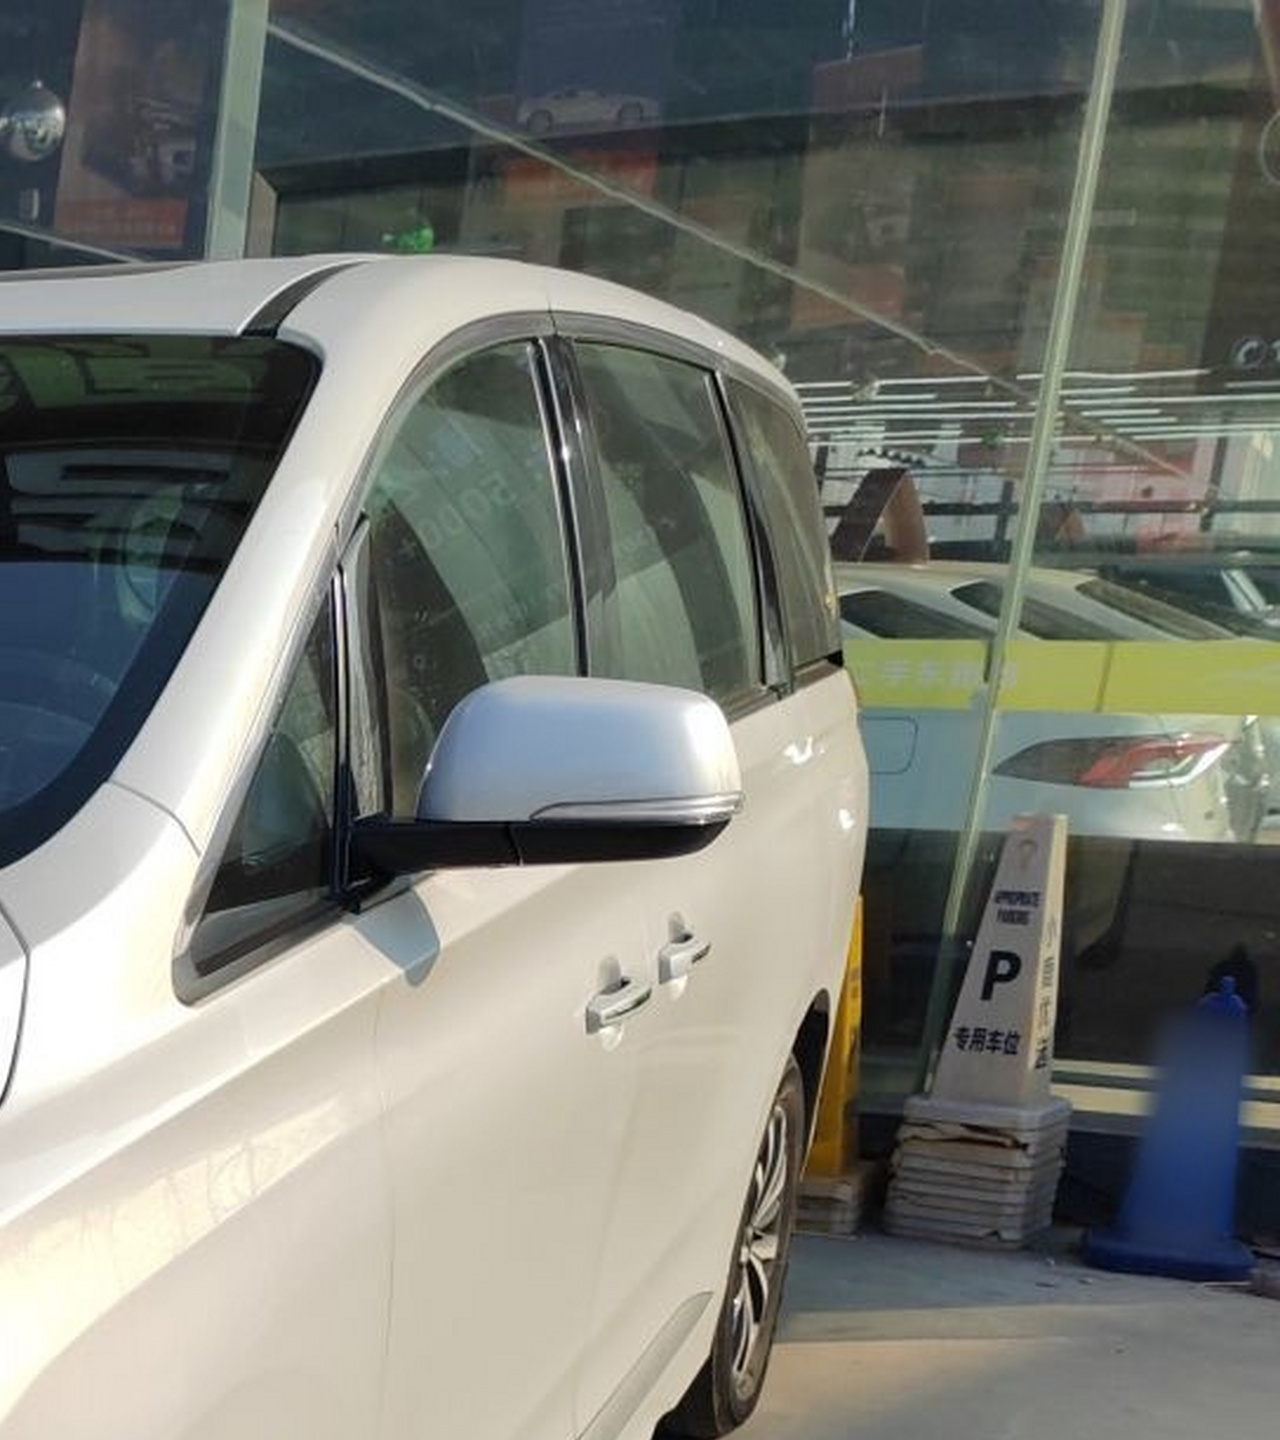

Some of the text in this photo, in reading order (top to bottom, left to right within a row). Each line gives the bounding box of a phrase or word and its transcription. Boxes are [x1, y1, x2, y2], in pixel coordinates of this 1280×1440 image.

[980, 949, 1023, 1001] P
[954, 1026, 1021, 1055] 专用车位
